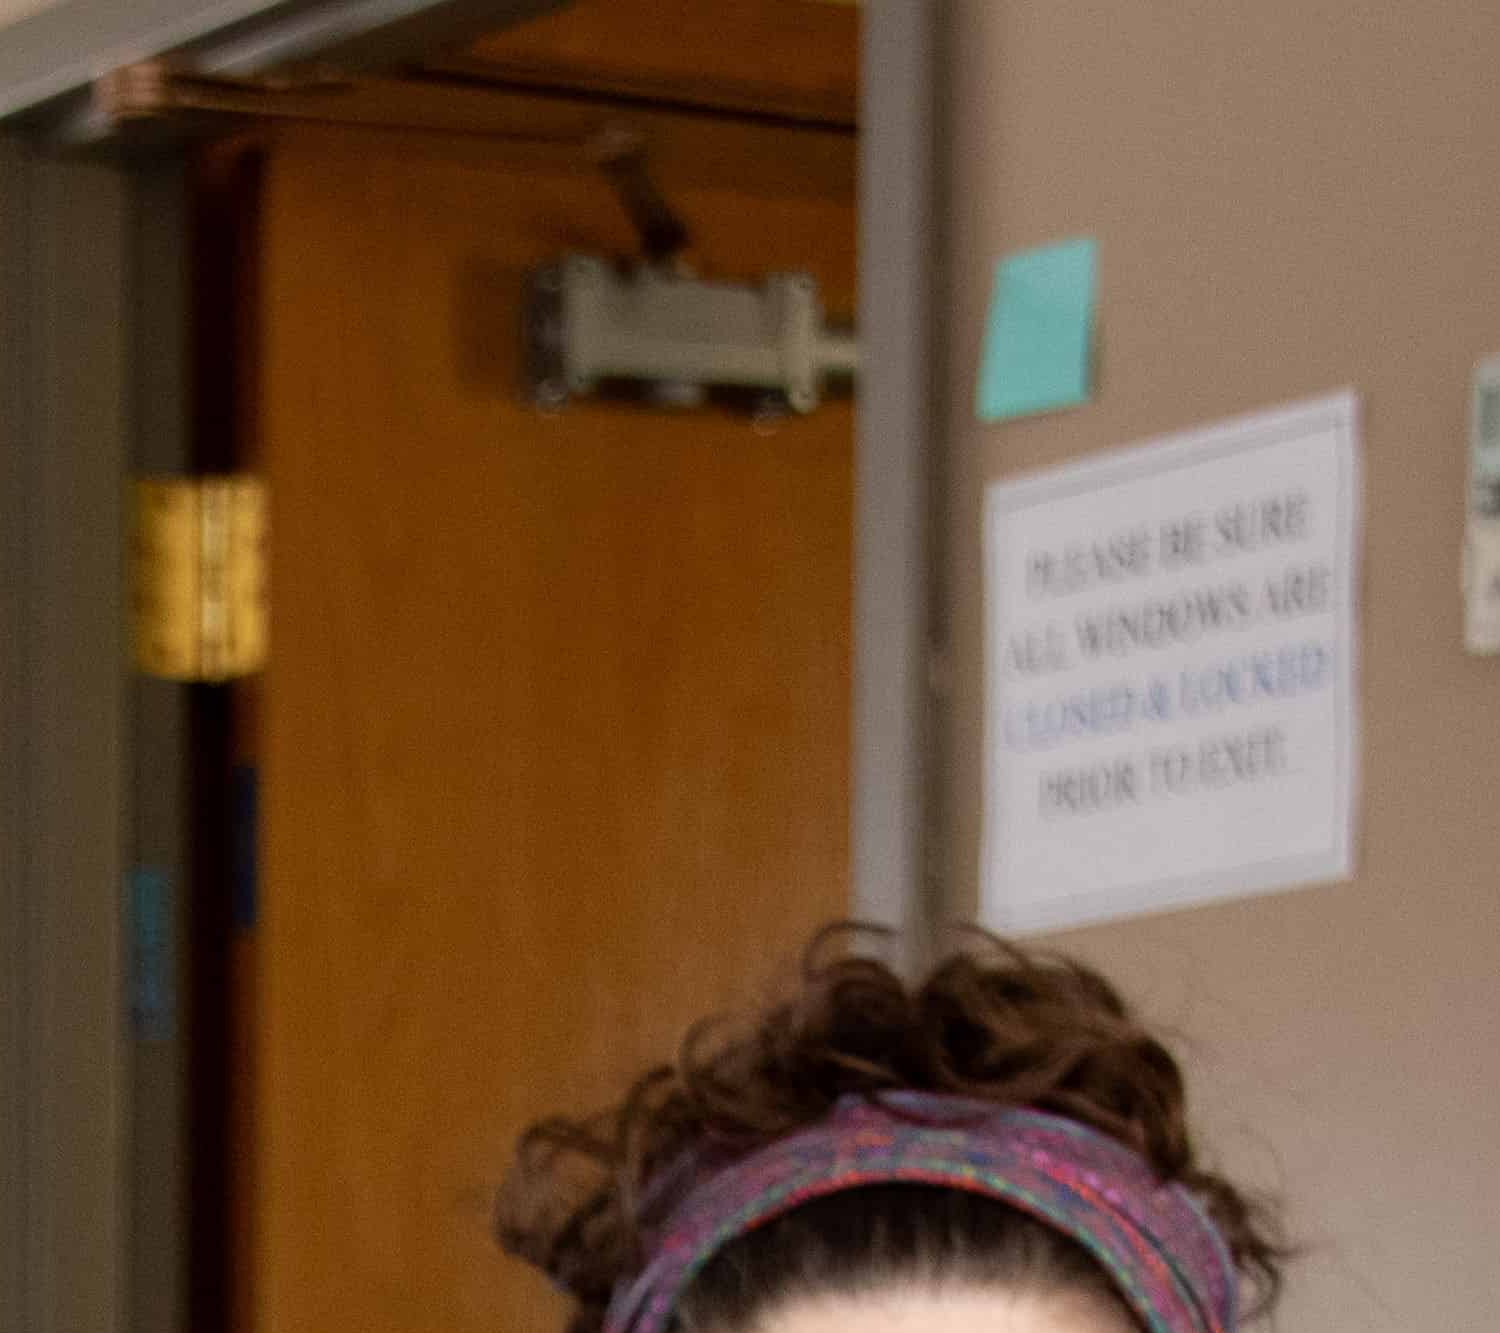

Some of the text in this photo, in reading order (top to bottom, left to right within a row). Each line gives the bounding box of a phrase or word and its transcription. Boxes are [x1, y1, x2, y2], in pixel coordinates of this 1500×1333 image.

[1025, 492, 1311, 597] PLEASE BE SURE
[1007, 558, 1331, 677] ALL WINDOWS ARE
[1002, 683, 1137, 750] CLOSED
[1178, 642, 1330, 714] LOCKED
[1039, 757, 1142, 819] PRIOR
[1150, 744, 1193, 796] TO
